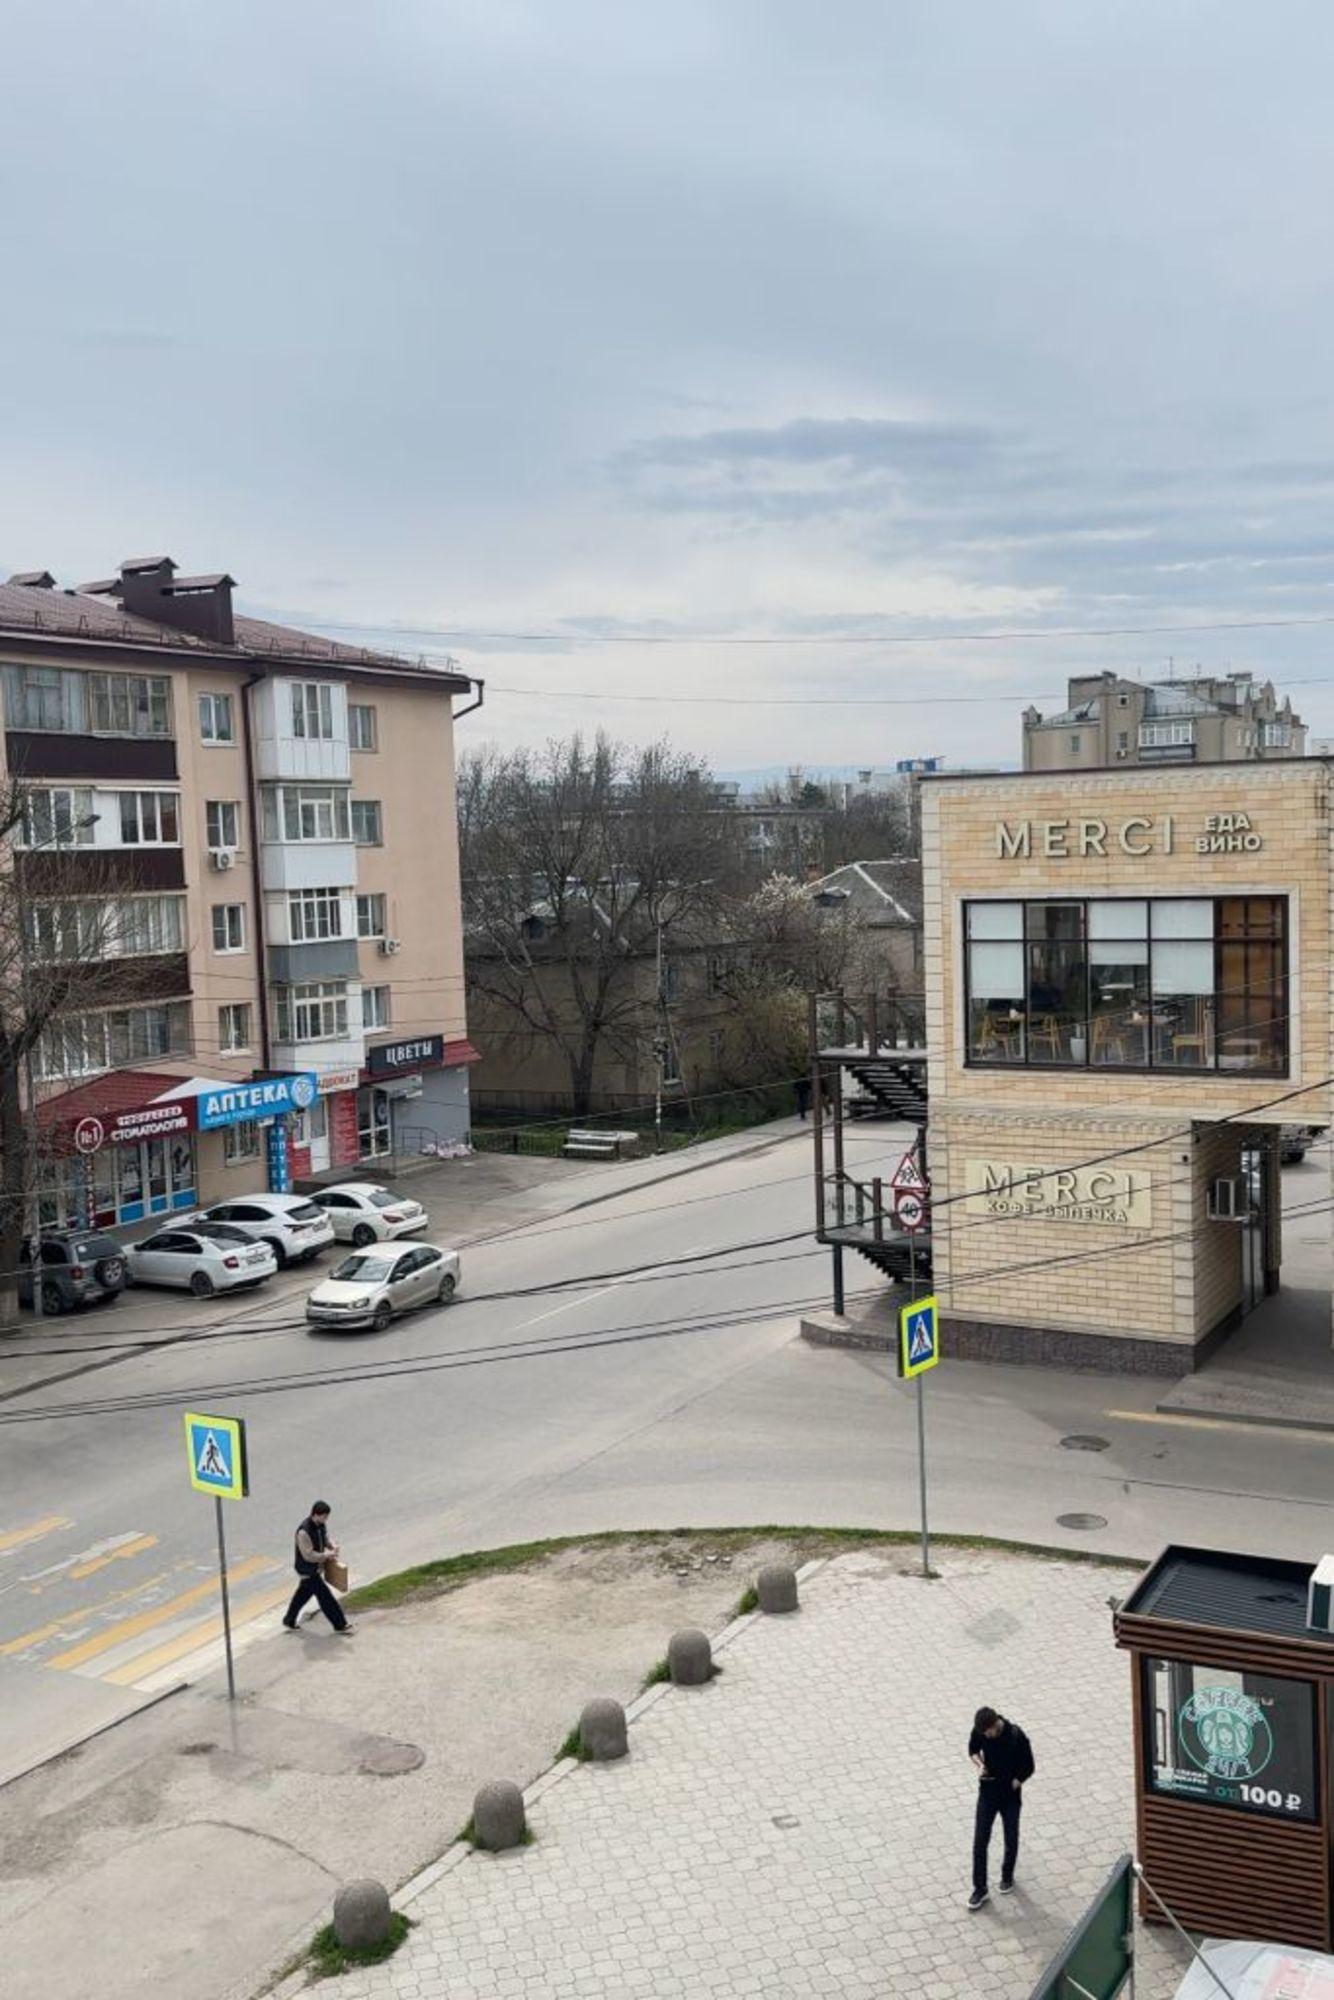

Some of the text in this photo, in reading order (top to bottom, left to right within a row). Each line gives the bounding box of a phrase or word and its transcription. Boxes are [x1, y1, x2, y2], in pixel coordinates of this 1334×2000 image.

[1205, 813, 1251, 832] ЕДА
[996, 814, 1175, 859] MERCI
[1195, 833, 1262, 855] ВИНО
[385, 1040, 433, 1067] ЦВЕТЫ
[206, 1082, 289, 1116] АПТЕКА
[983, 1164, 1134, 1208] MERCI
[987, 1200, 1033, 1215] КОФЕ
